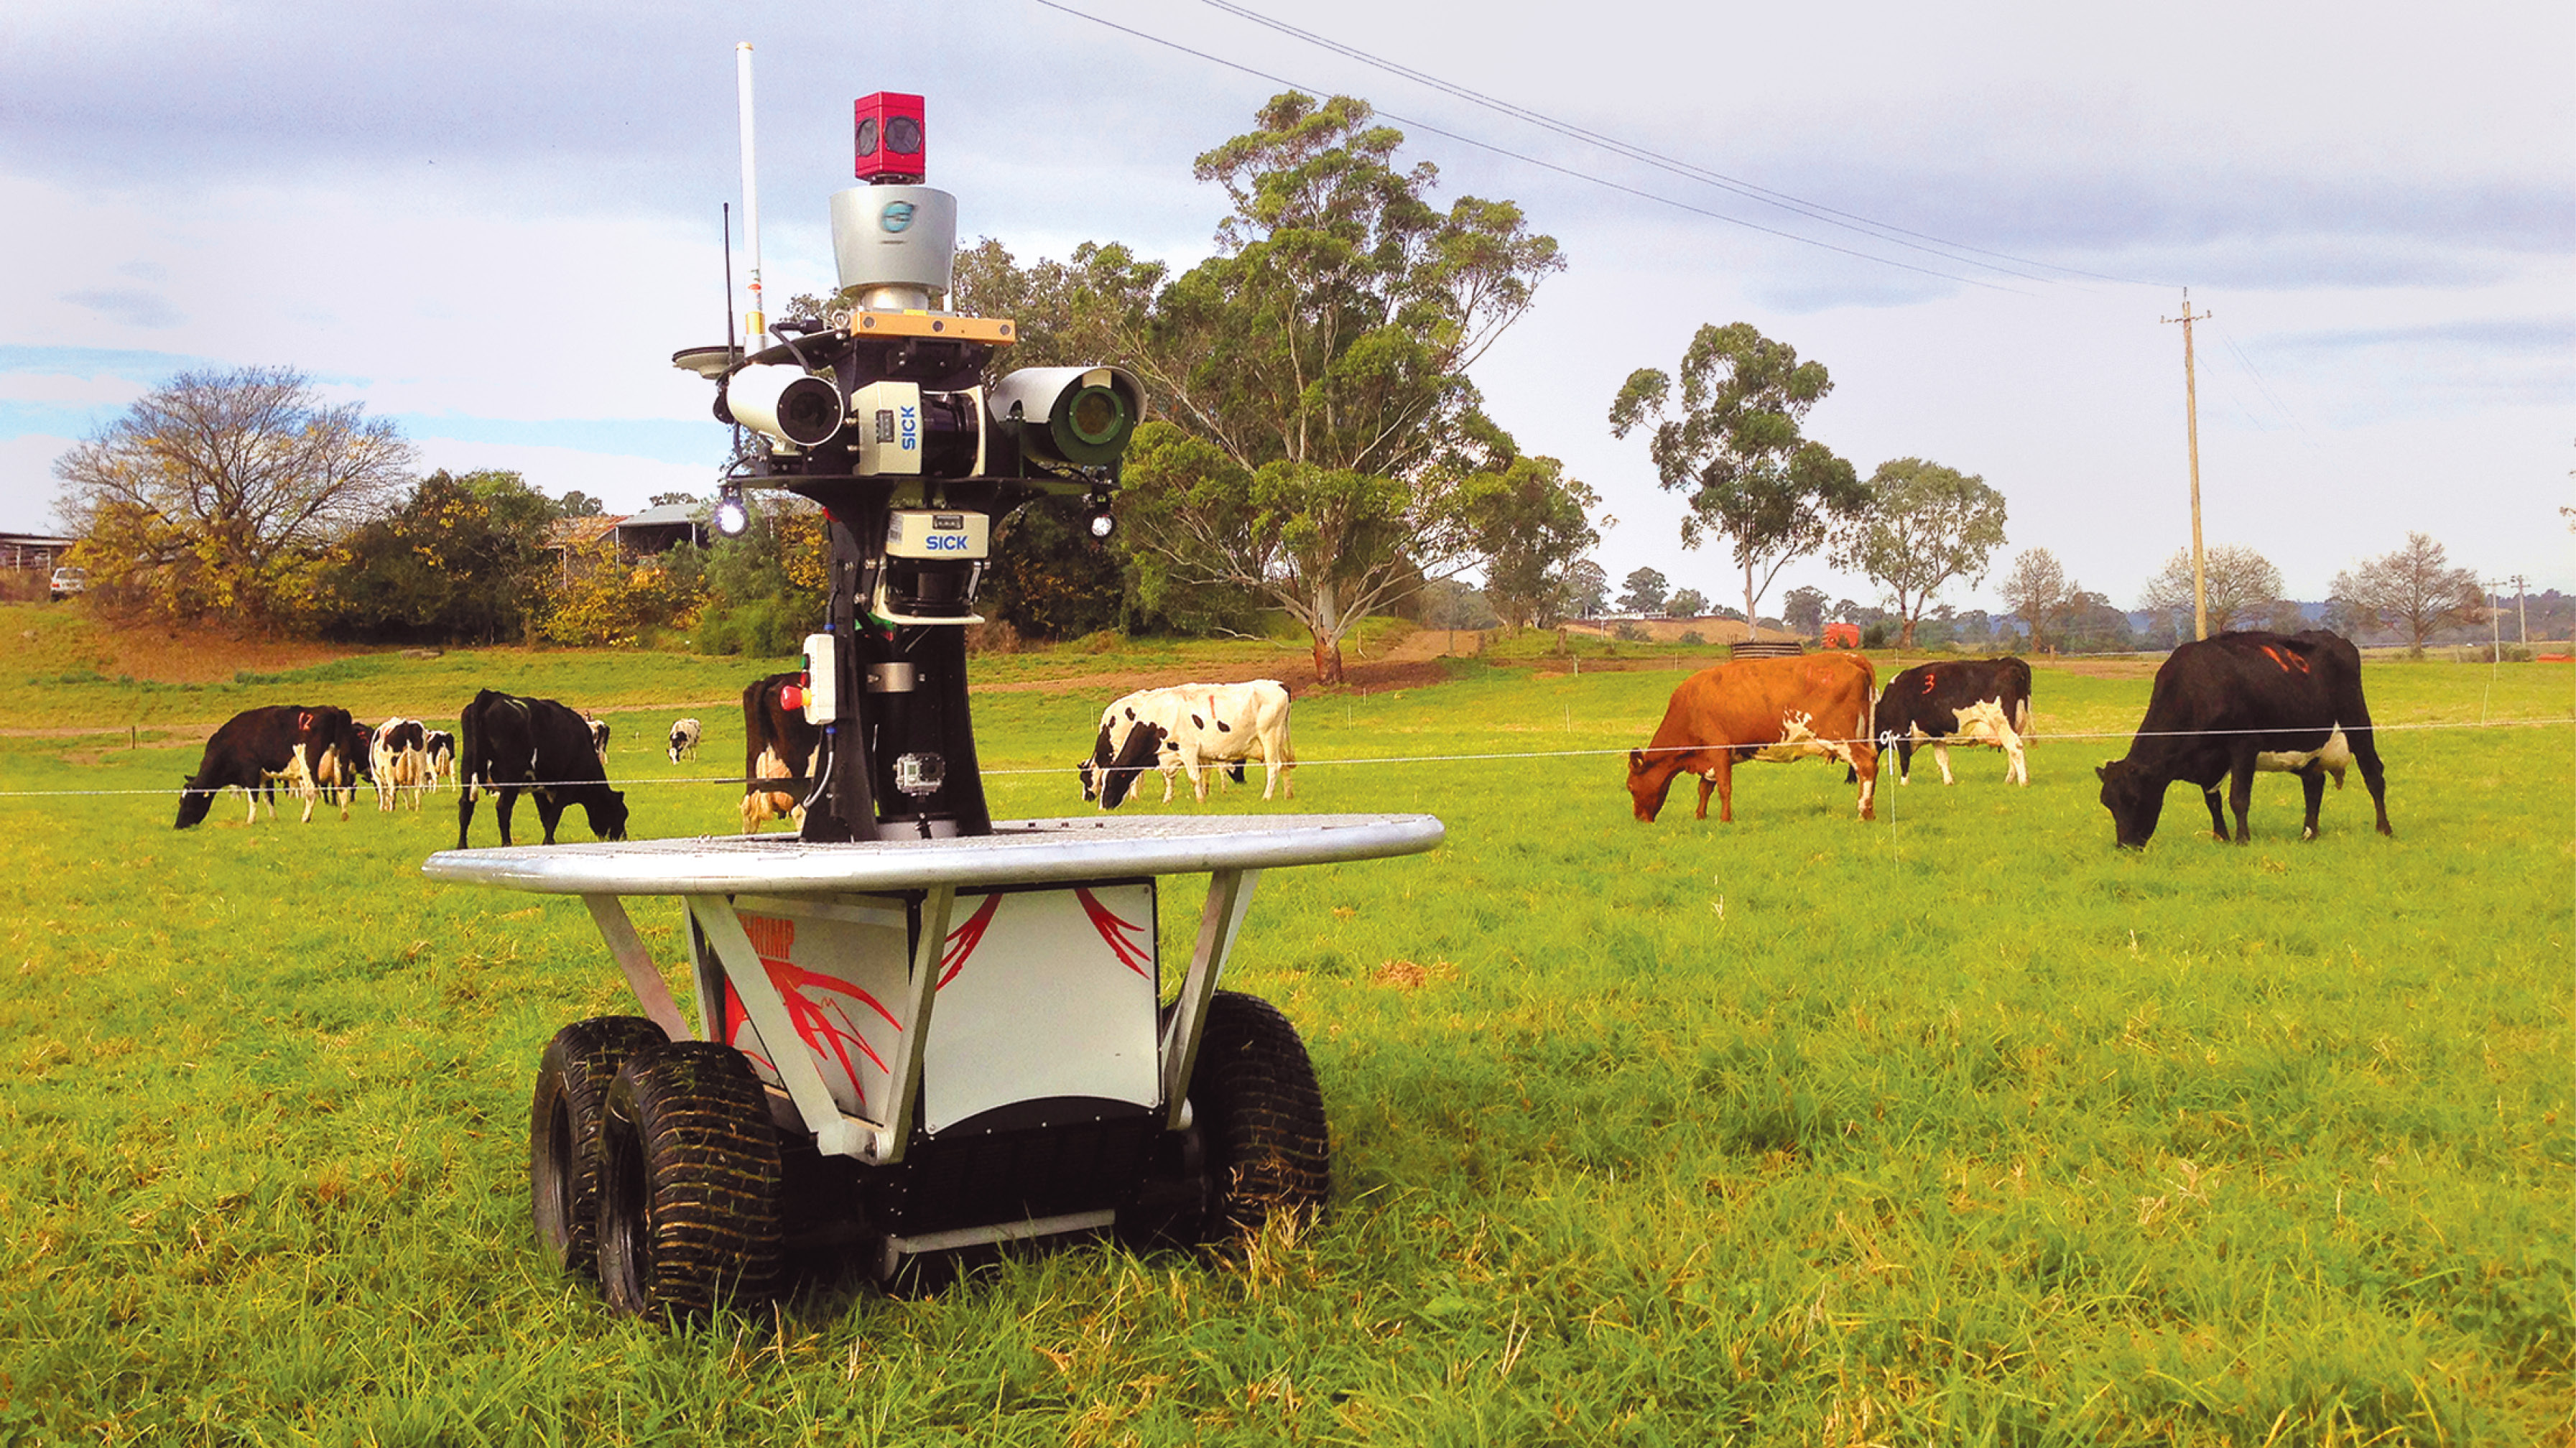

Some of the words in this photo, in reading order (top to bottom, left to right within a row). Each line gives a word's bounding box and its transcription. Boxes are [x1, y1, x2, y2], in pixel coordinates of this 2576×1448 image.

[901, 406, 916, 450] SICK
[925, 535, 968, 550] SICK
[1922, 673, 1935, 695] 3
[299, 712, 314, 730] 12
